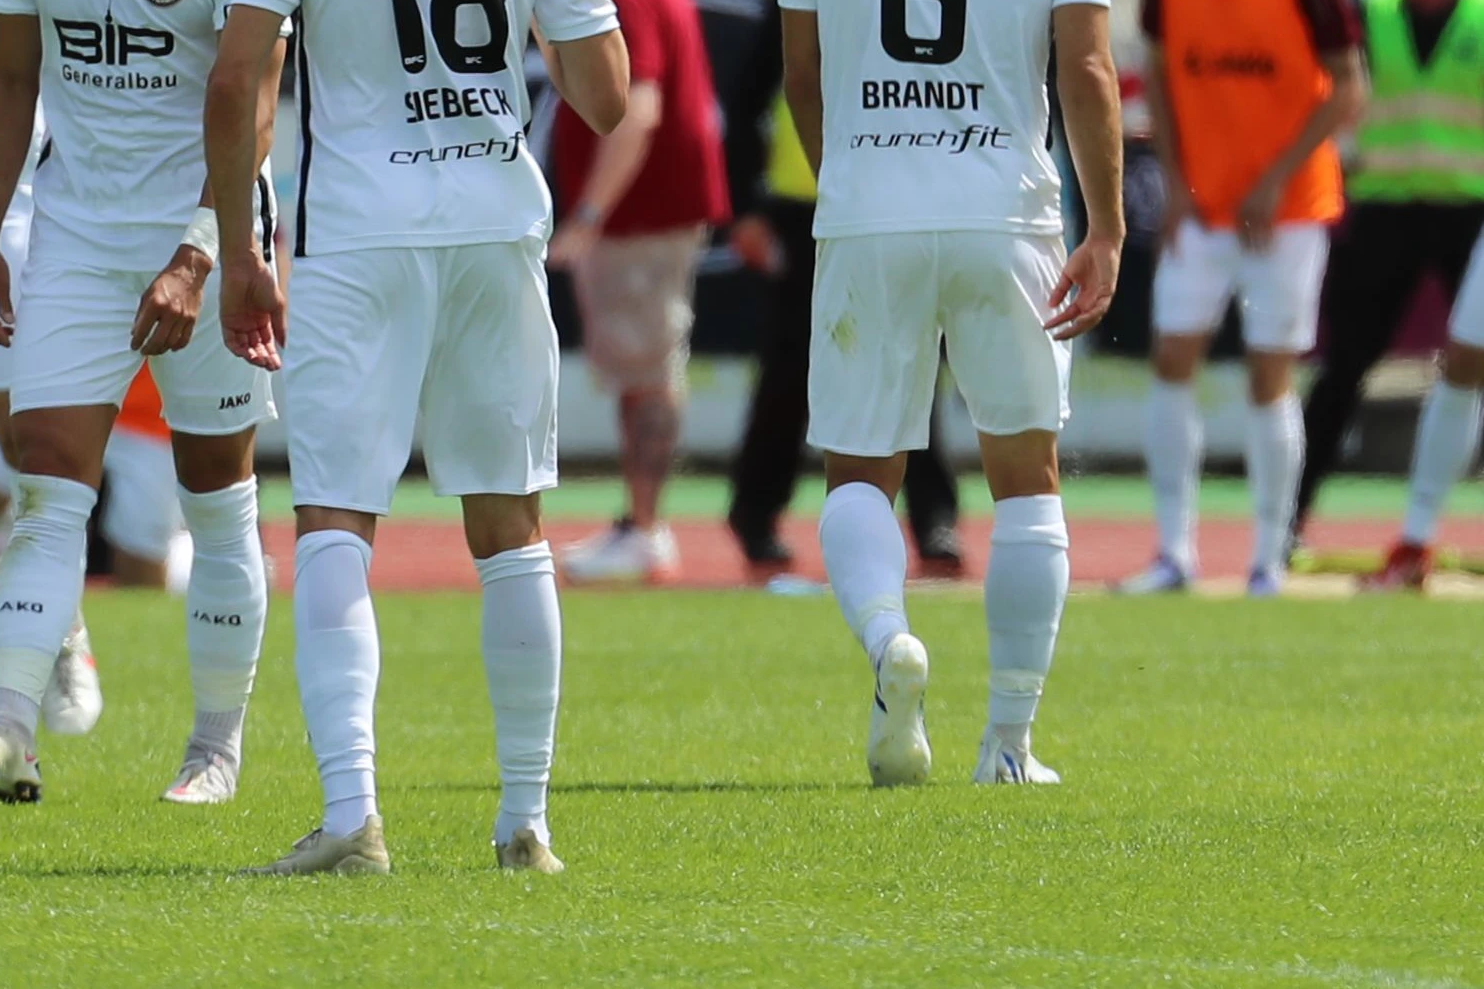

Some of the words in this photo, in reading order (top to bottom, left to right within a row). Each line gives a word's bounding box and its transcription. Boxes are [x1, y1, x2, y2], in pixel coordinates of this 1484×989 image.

[62, 64, 178, 90] Generalbau
[862, 80, 984, 110] BRANDT
[219, 392, 251, 410] JAKO
[192, 610, 242, 626] JAKO
